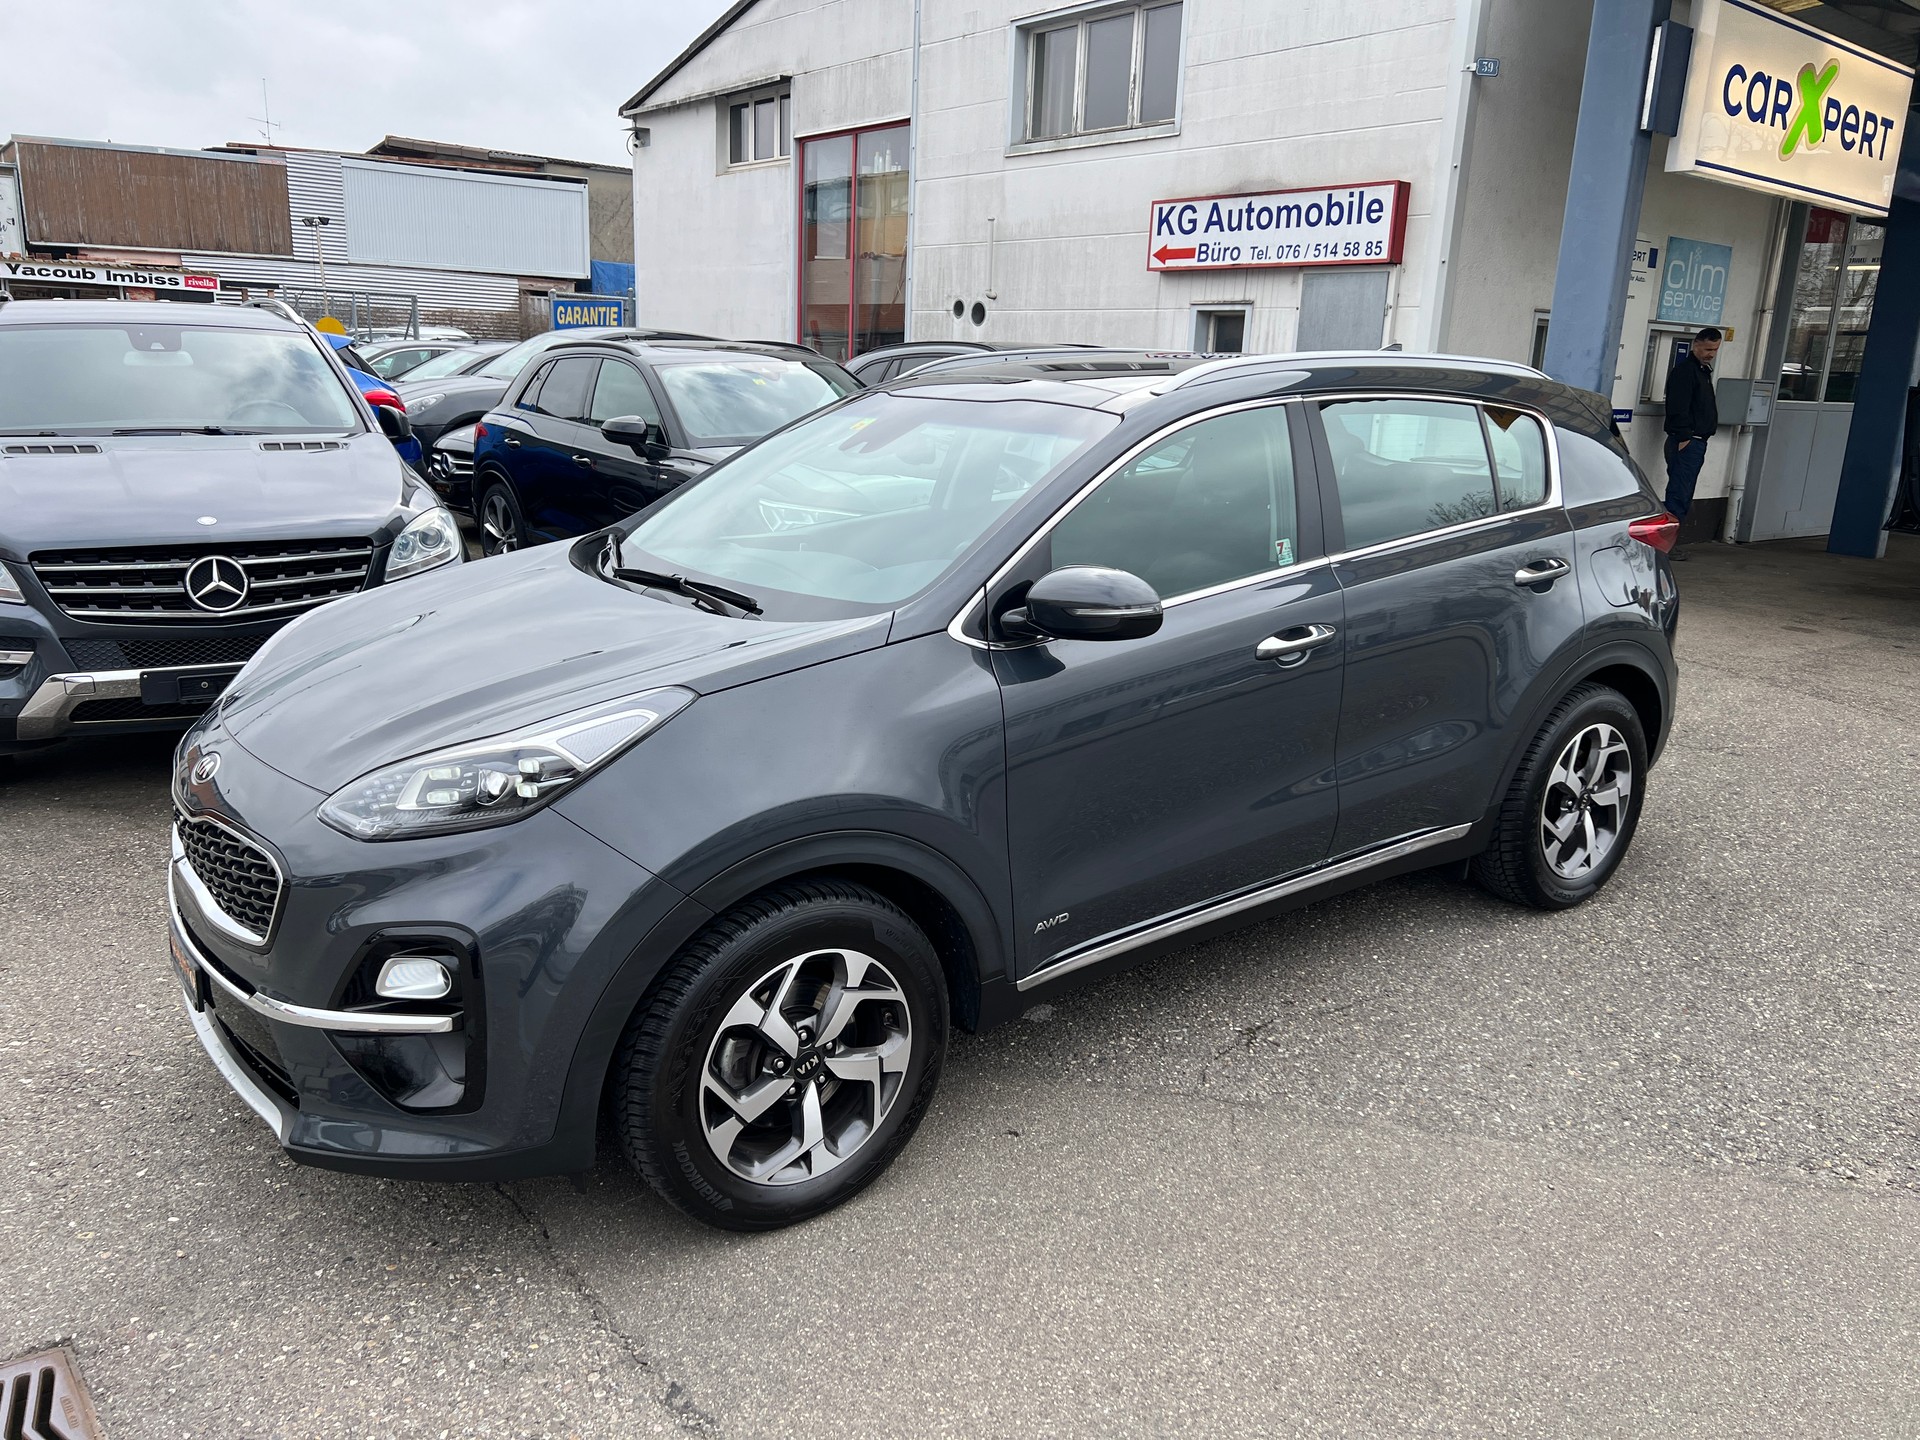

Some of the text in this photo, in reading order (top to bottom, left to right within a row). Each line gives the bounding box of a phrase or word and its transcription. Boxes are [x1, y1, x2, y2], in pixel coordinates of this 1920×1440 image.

[1156, 190, 1384, 236] KG Automobile
[1196, 242, 1241, 263] Büro
[1250, 246, 1272, 260] Tel.
[1277, 244, 1301, 259] 076
[1313, 243, 1338, 258] 514
[1343, 241, 1360, 256] 58
[1365, 240, 1383, 256] 85
[5, 263, 180, 286] Yacoub Imbiss
[187, 278, 215, 288] rivella
[1667, 250, 1725, 294] clim
[1663, 290, 1722, 312] service
[557, 305, 619, 326] GARANTIE
[1034, 912, 1070, 935] AWD
[796, 1054, 820, 1075] KIA
